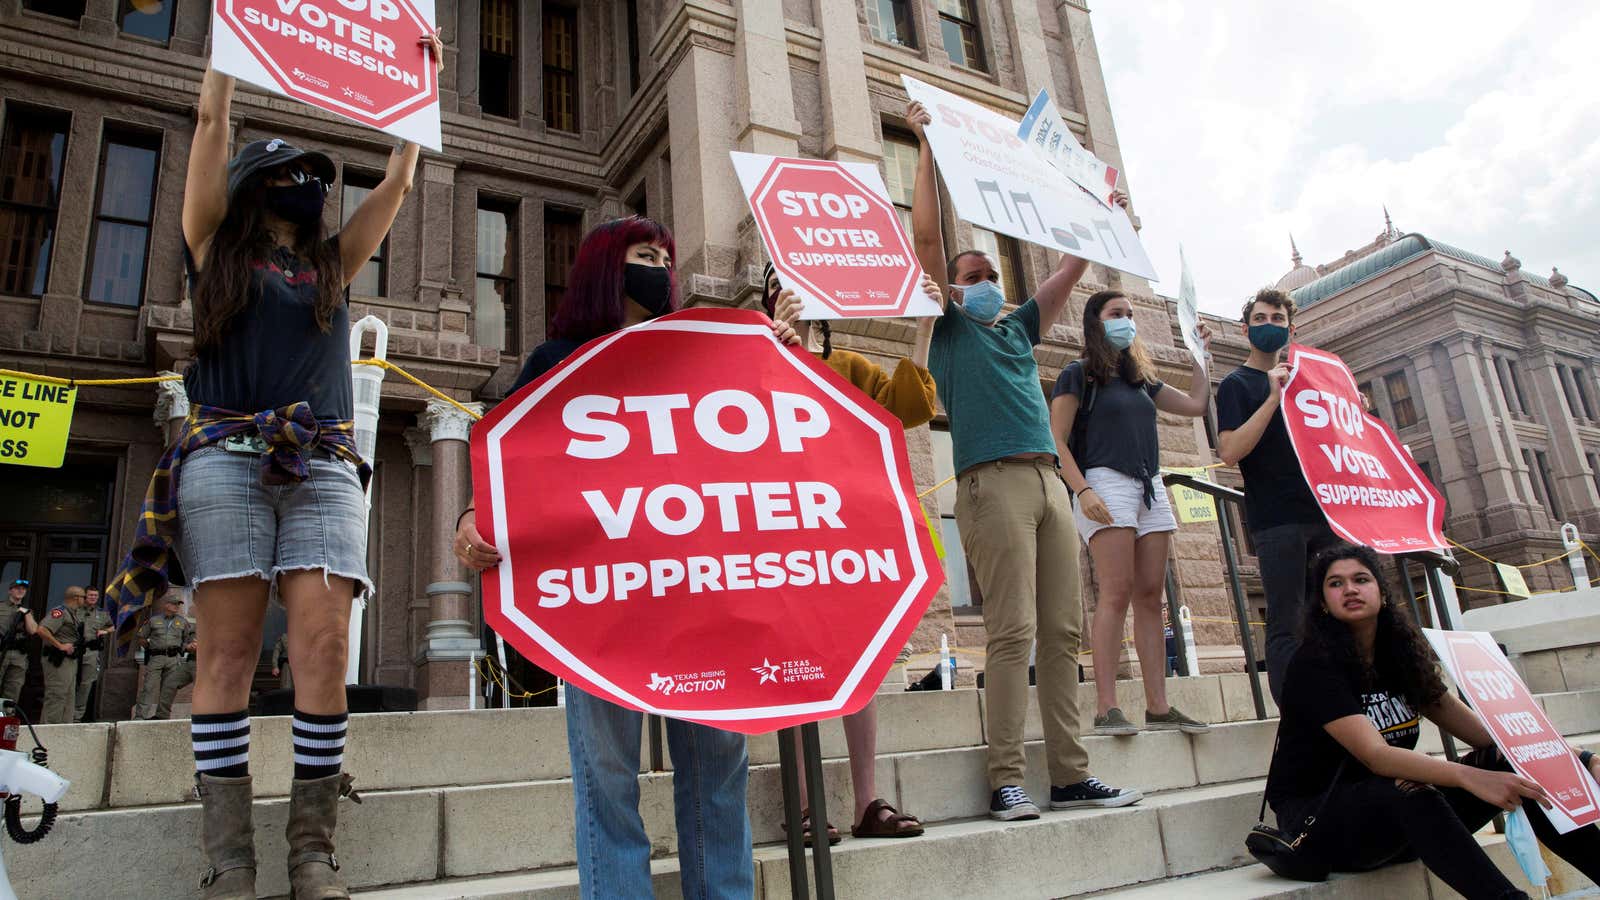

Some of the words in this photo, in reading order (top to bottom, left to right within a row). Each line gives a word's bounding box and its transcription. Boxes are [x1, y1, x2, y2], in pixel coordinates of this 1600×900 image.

[276, 0, 396, 59] VOTER
[244, 7, 419, 89] SUPPRESSION
[776, 189, 869, 219] STOP
[793, 226, 883, 248] VOTER
[788, 252, 907, 267] SUPPRESSION
[22, 383, 70, 404] LINE
[0, 408, 40, 429] NOT
[562, 389, 831, 459] STOP
[1295, 389, 1365, 439] STOP
[1319, 444, 1391, 480] VOTER
[1316, 483, 1424, 507] SUPPRESSION
[581, 481, 847, 539] VOTER
[537, 548, 901, 608] SUPPRESSION
[674, 673, 698, 681] TEXAS
[701, 670, 726, 679] RISING
[782, 659, 810, 668] TEXAS
[783, 666, 822, 675] FREEDOM
[674, 679, 726, 693] ACTION
[784, 673, 825, 683] NETWORK
[1464, 669, 1515, 701] STOP
[1494, 711, 1544, 736] VOTER
[1510, 739, 1569, 763] SUPPRESSION
